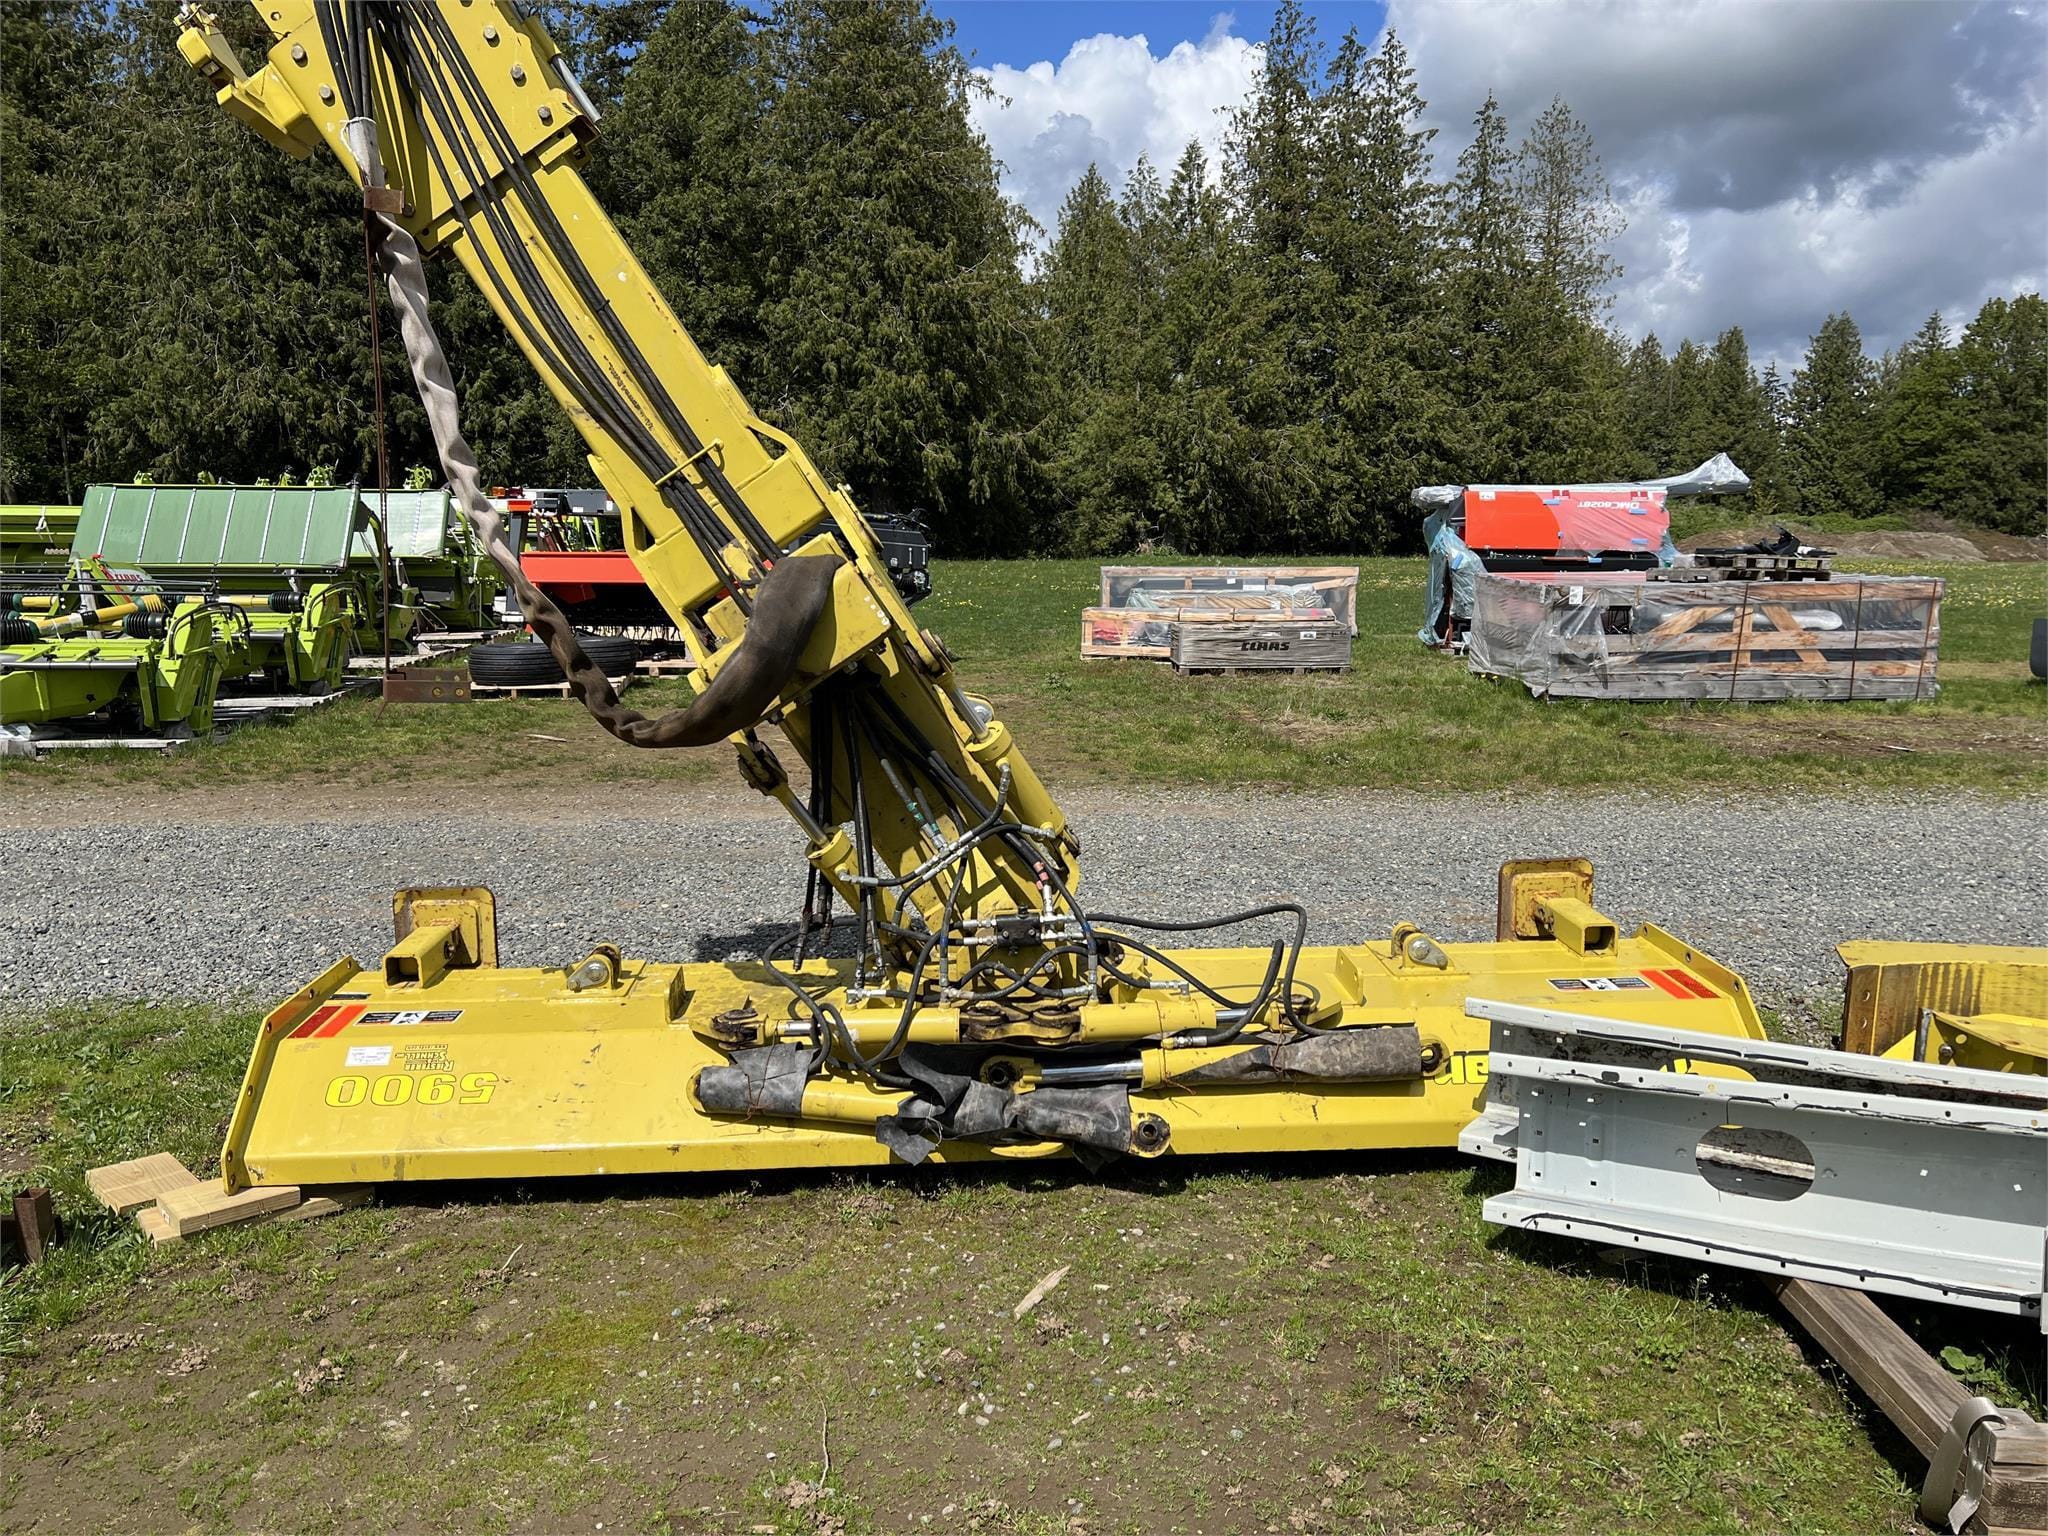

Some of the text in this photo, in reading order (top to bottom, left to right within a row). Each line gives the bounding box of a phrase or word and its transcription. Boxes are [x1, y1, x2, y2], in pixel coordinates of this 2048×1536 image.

[1241, 641, 1291, 651] CLAAS
[406, 1051, 447, 1061] SCHNELL
[324, 1072, 500, 1107] 5900
